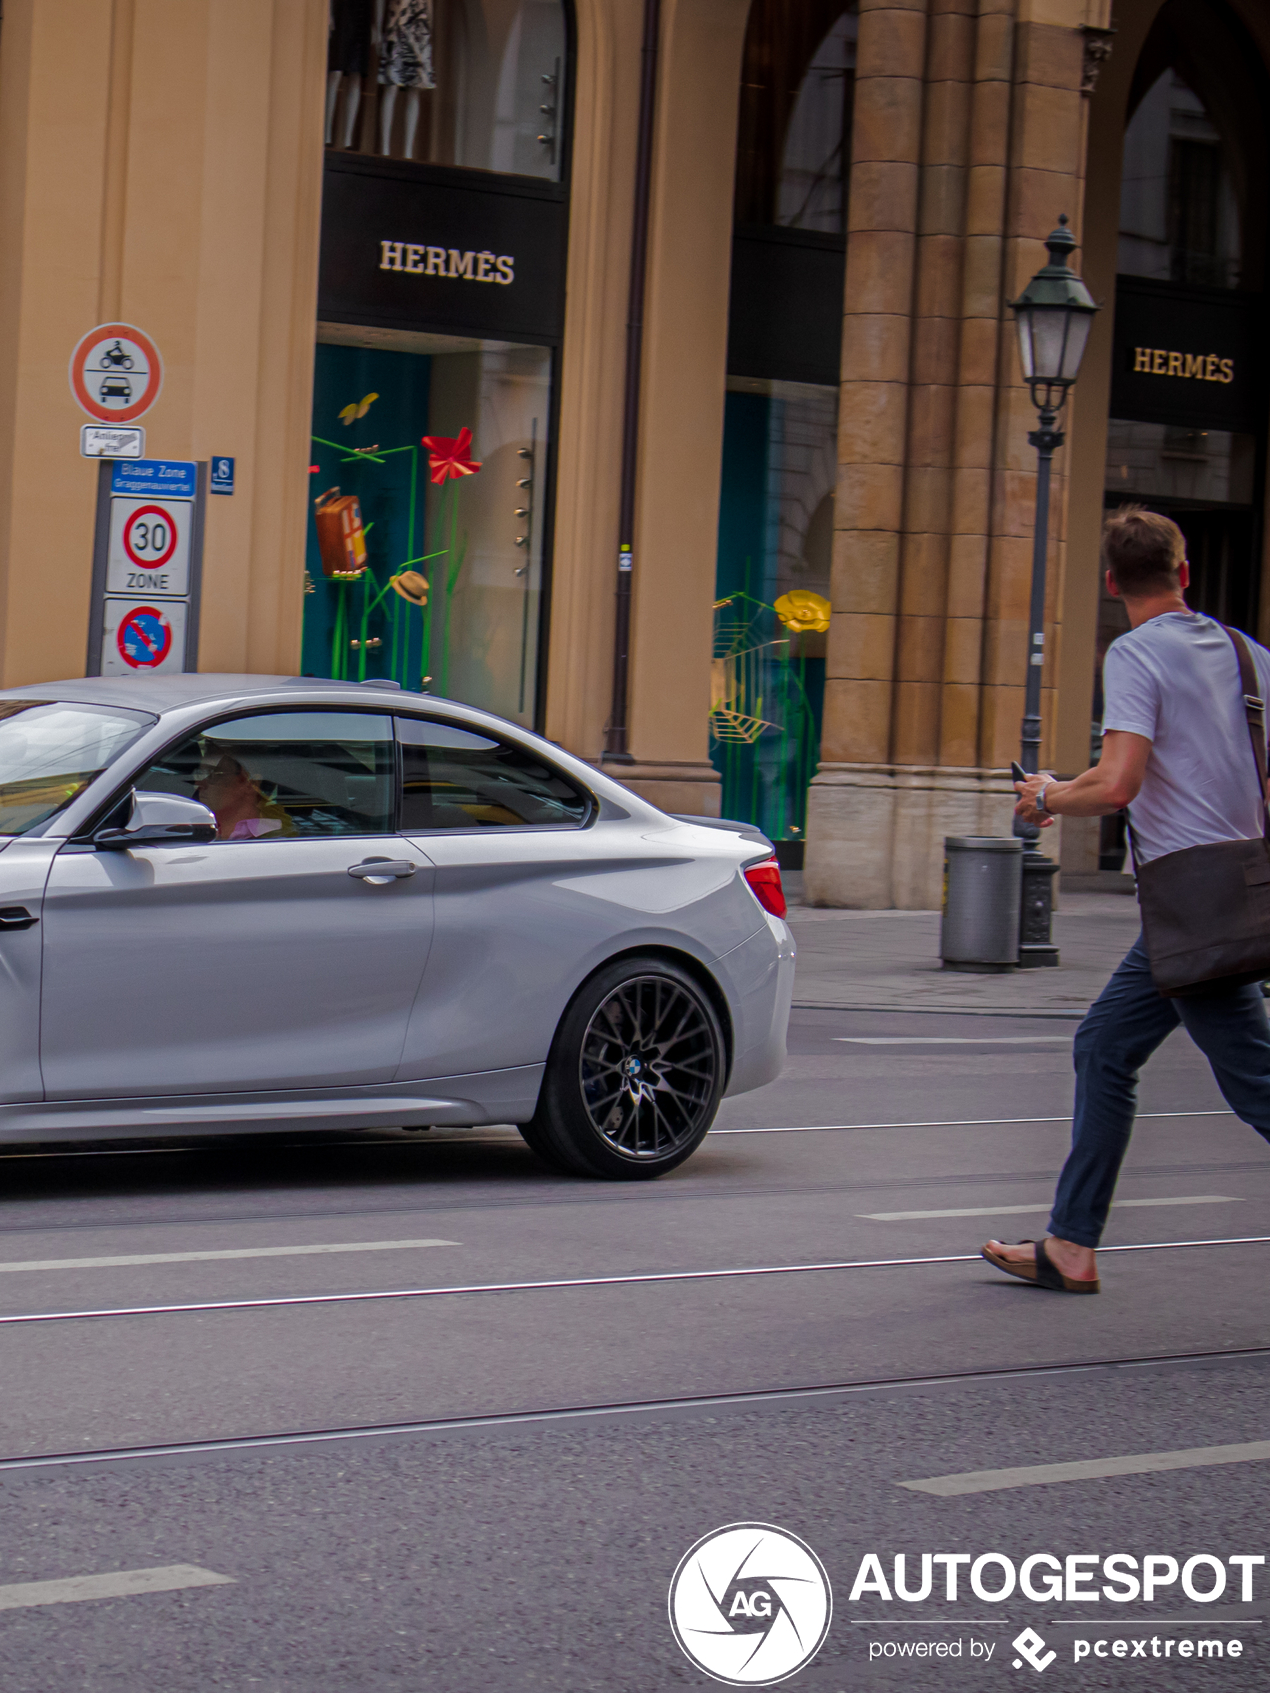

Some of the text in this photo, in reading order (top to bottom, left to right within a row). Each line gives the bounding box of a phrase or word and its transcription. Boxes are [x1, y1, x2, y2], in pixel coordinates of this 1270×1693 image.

[121, 463, 186, 478] Blaue Zone
[218, 459, 230, 478] 8
[135, 522, 166, 551] 30
[126, 572, 169, 589] ZONE
